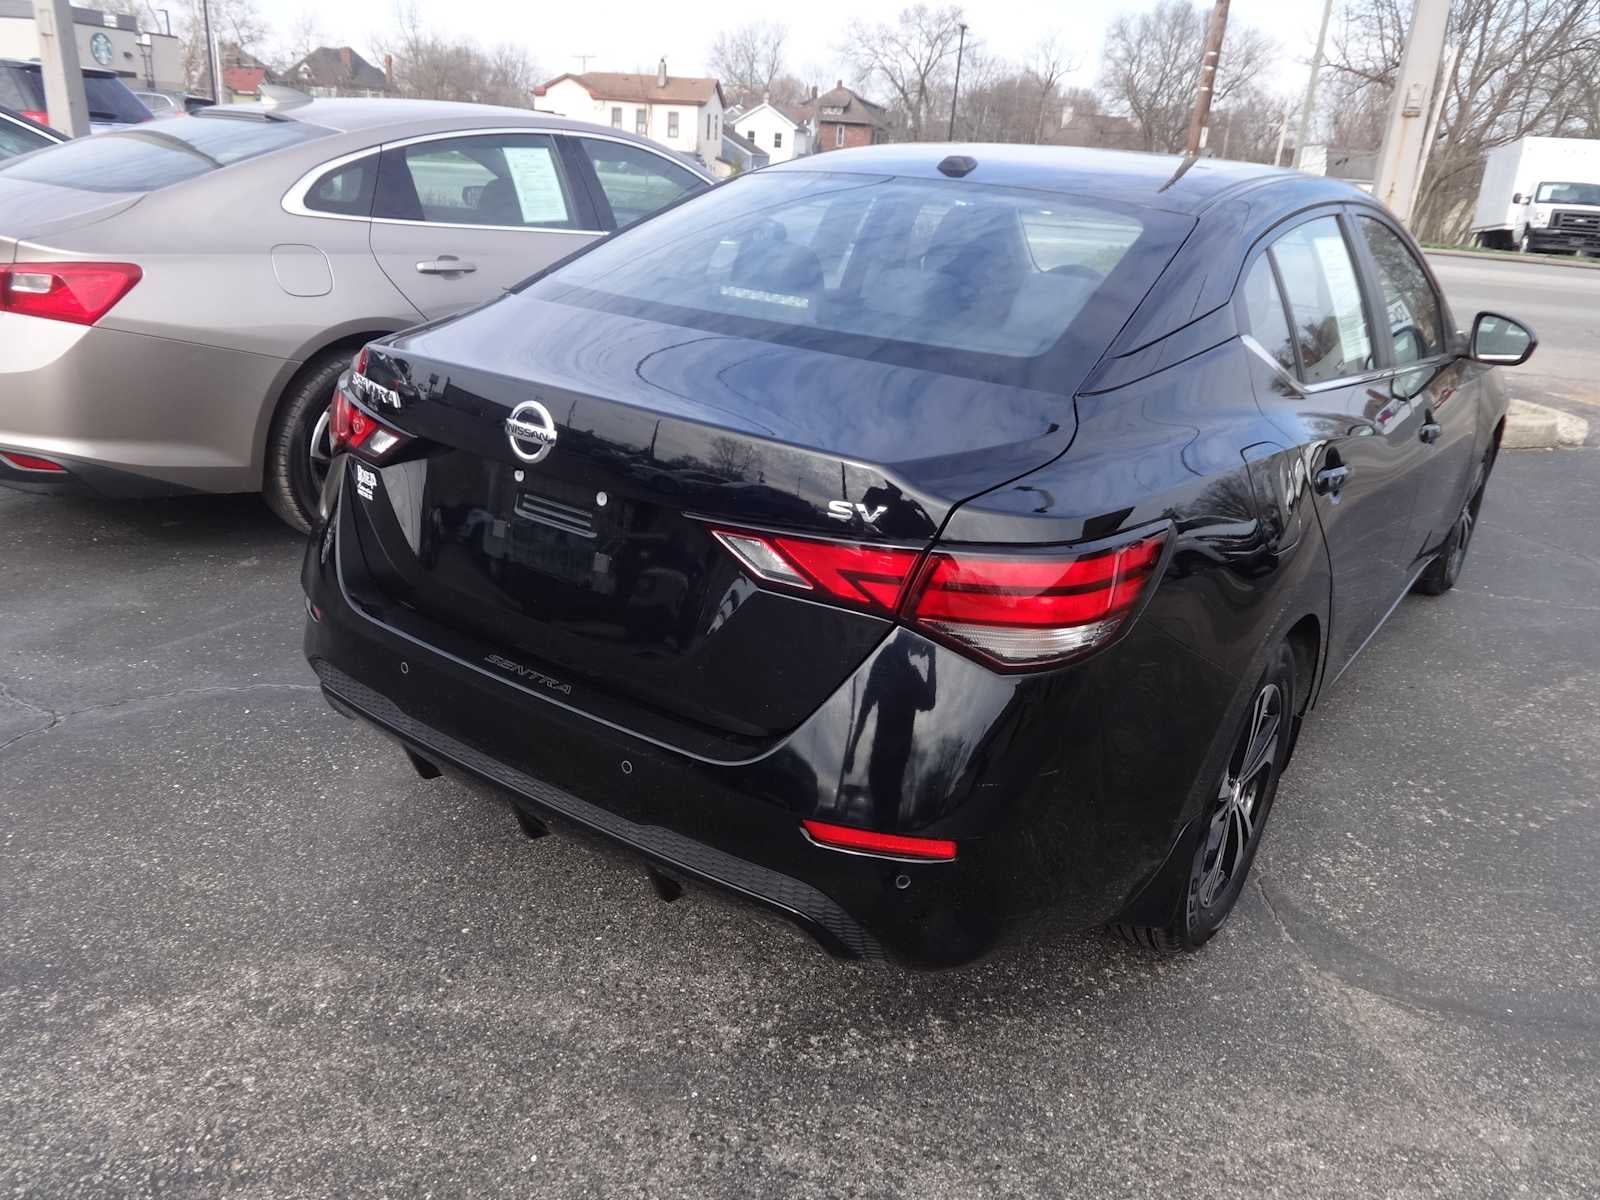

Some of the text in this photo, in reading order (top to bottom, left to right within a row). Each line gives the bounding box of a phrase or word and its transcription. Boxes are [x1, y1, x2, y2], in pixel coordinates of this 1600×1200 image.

[352, 371, 401, 409] SENTRA
[505, 422, 549, 442] NISSAN
[827, 500, 888, 522] SV
[484, 654, 572, 695] SENTRA
